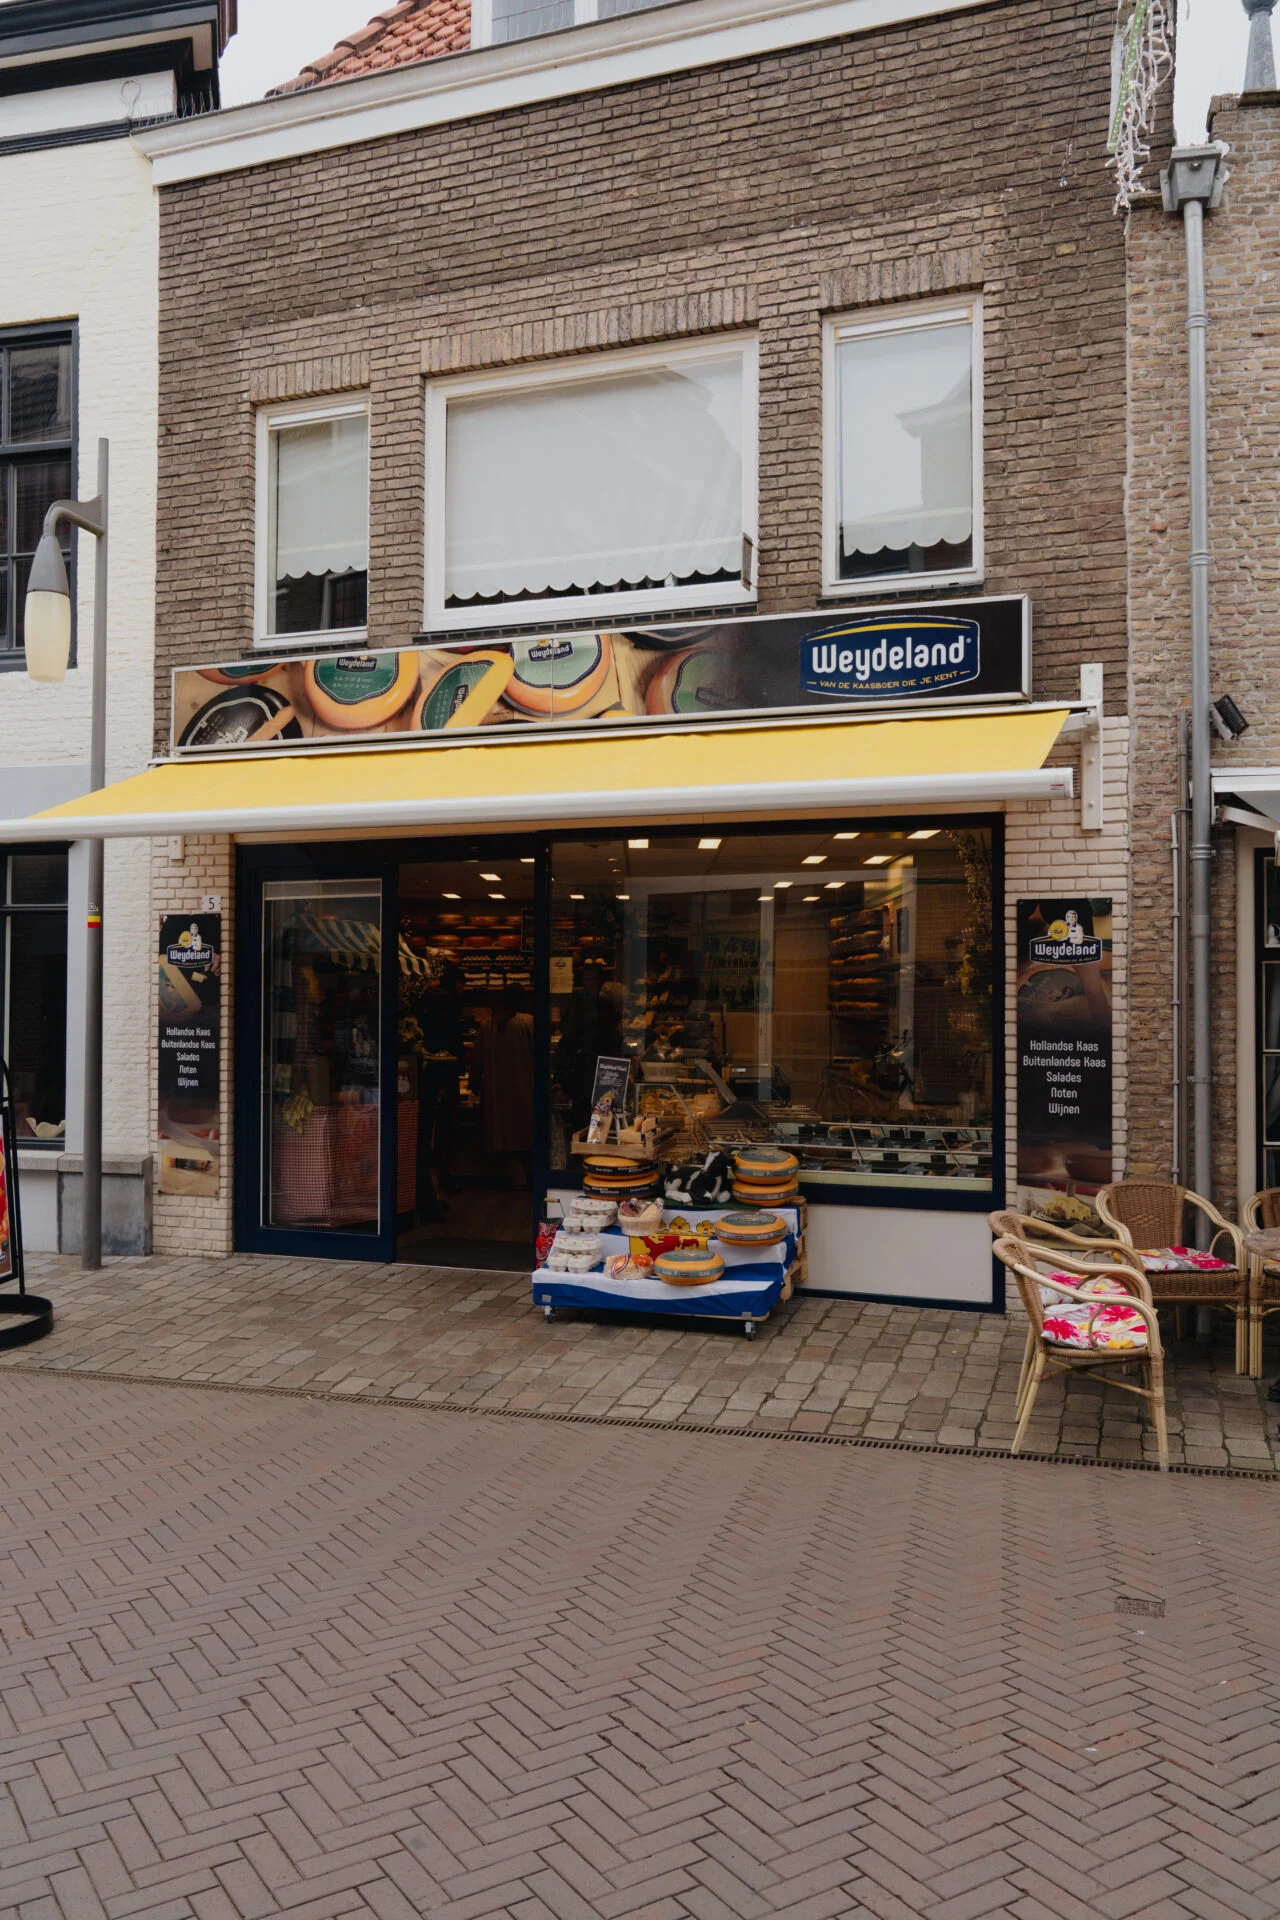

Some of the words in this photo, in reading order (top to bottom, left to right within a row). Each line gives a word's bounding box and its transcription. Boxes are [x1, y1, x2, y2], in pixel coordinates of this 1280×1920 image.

[531, 644, 570, 658] Weydeland
[338, 658, 375, 669] Weydeland
[812, 635, 965, 681] Weydeland
[819, 680, 836, 688] VAN
[838, 681, 851, 689] DE
[853, 680, 900, 690] KAASBOER
[902, 679, 917, 688] DIE
[920, 676, 932, 684] JE
[934, 670, 959, 682] KENT
[208, 897, 215, 910] 5
[170, 949, 210, 962] Weydeland
[1034, 943, 1097, 959] Weydeland
[166, 1026, 195, 1036] Hollandse
[196, 1027, 211, 1036] Kaas
[161, 1039, 200, 1049] Buitenlandse
[200, 1040, 216, 1049] Kaas
[1029, 1040, 1074, 1051] Hollandse
[1076, 1040, 1099, 1052] Kaas
[176, 1052, 200, 1062] Salades
[1022, 1055, 1081, 1067] Buitenlandse
[1084, 1056, 1106, 1068] Kaas
[179, 1065, 197, 1074] Noten
[177, 1077, 199, 1089] Wijnen
[1046, 1071, 1082, 1083] Salades
[1050, 1087, 1078, 1099] Noten
[1048, 1102, 1080, 1117] Wijnen
